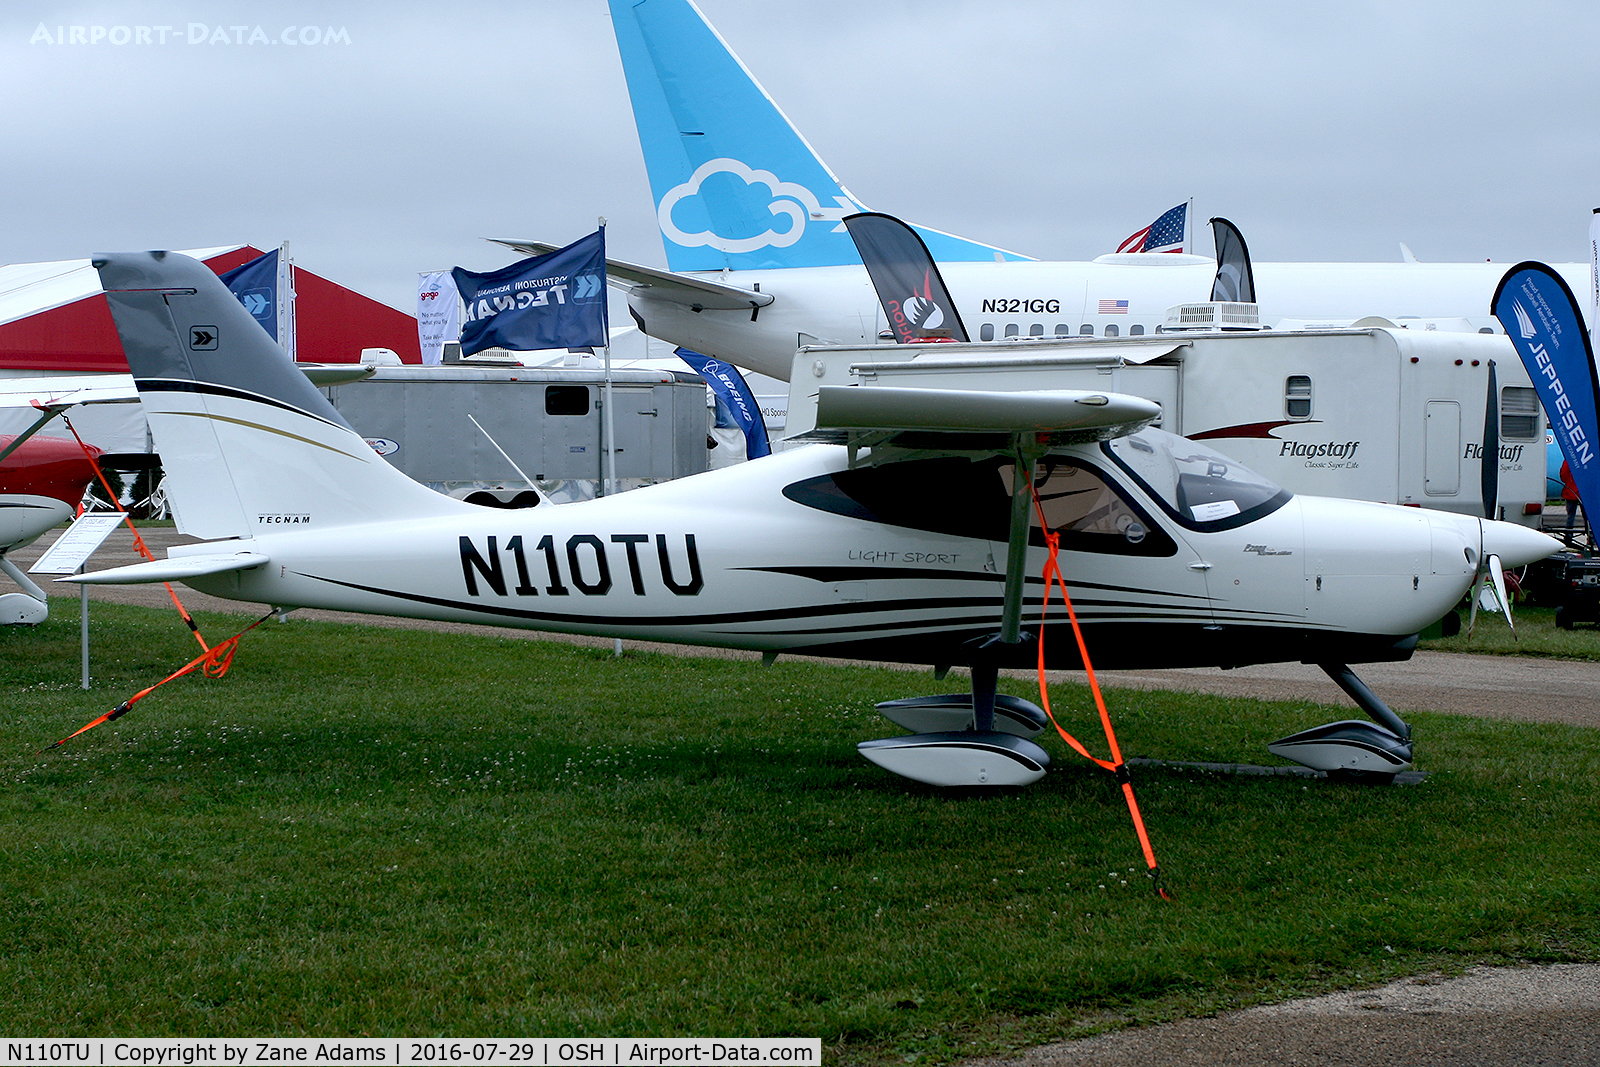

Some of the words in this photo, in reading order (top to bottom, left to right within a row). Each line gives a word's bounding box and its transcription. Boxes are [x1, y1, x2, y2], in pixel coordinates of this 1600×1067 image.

[1526, 276, 1539, 294] Proud
[420, 291, 439, 301] gogo
[981, 298, 1061, 314] N321GG
[717, 373, 753, 422] BOEING
[1528, 342, 1595, 465] JEPPESEN
[1279, 441, 1360, 460] Flagstaff
[1463, 443, 1524, 463] Flataff
[1304, 460, 1327, 469] Classic
[1327, 460, 1345, 471] Super
[258, 516, 311, 524] TECNAM
[458, 533, 705, 597] N110TU
[848, 550, 899, 564] LIGHT
[902, 552, 962, 564] SPORT
